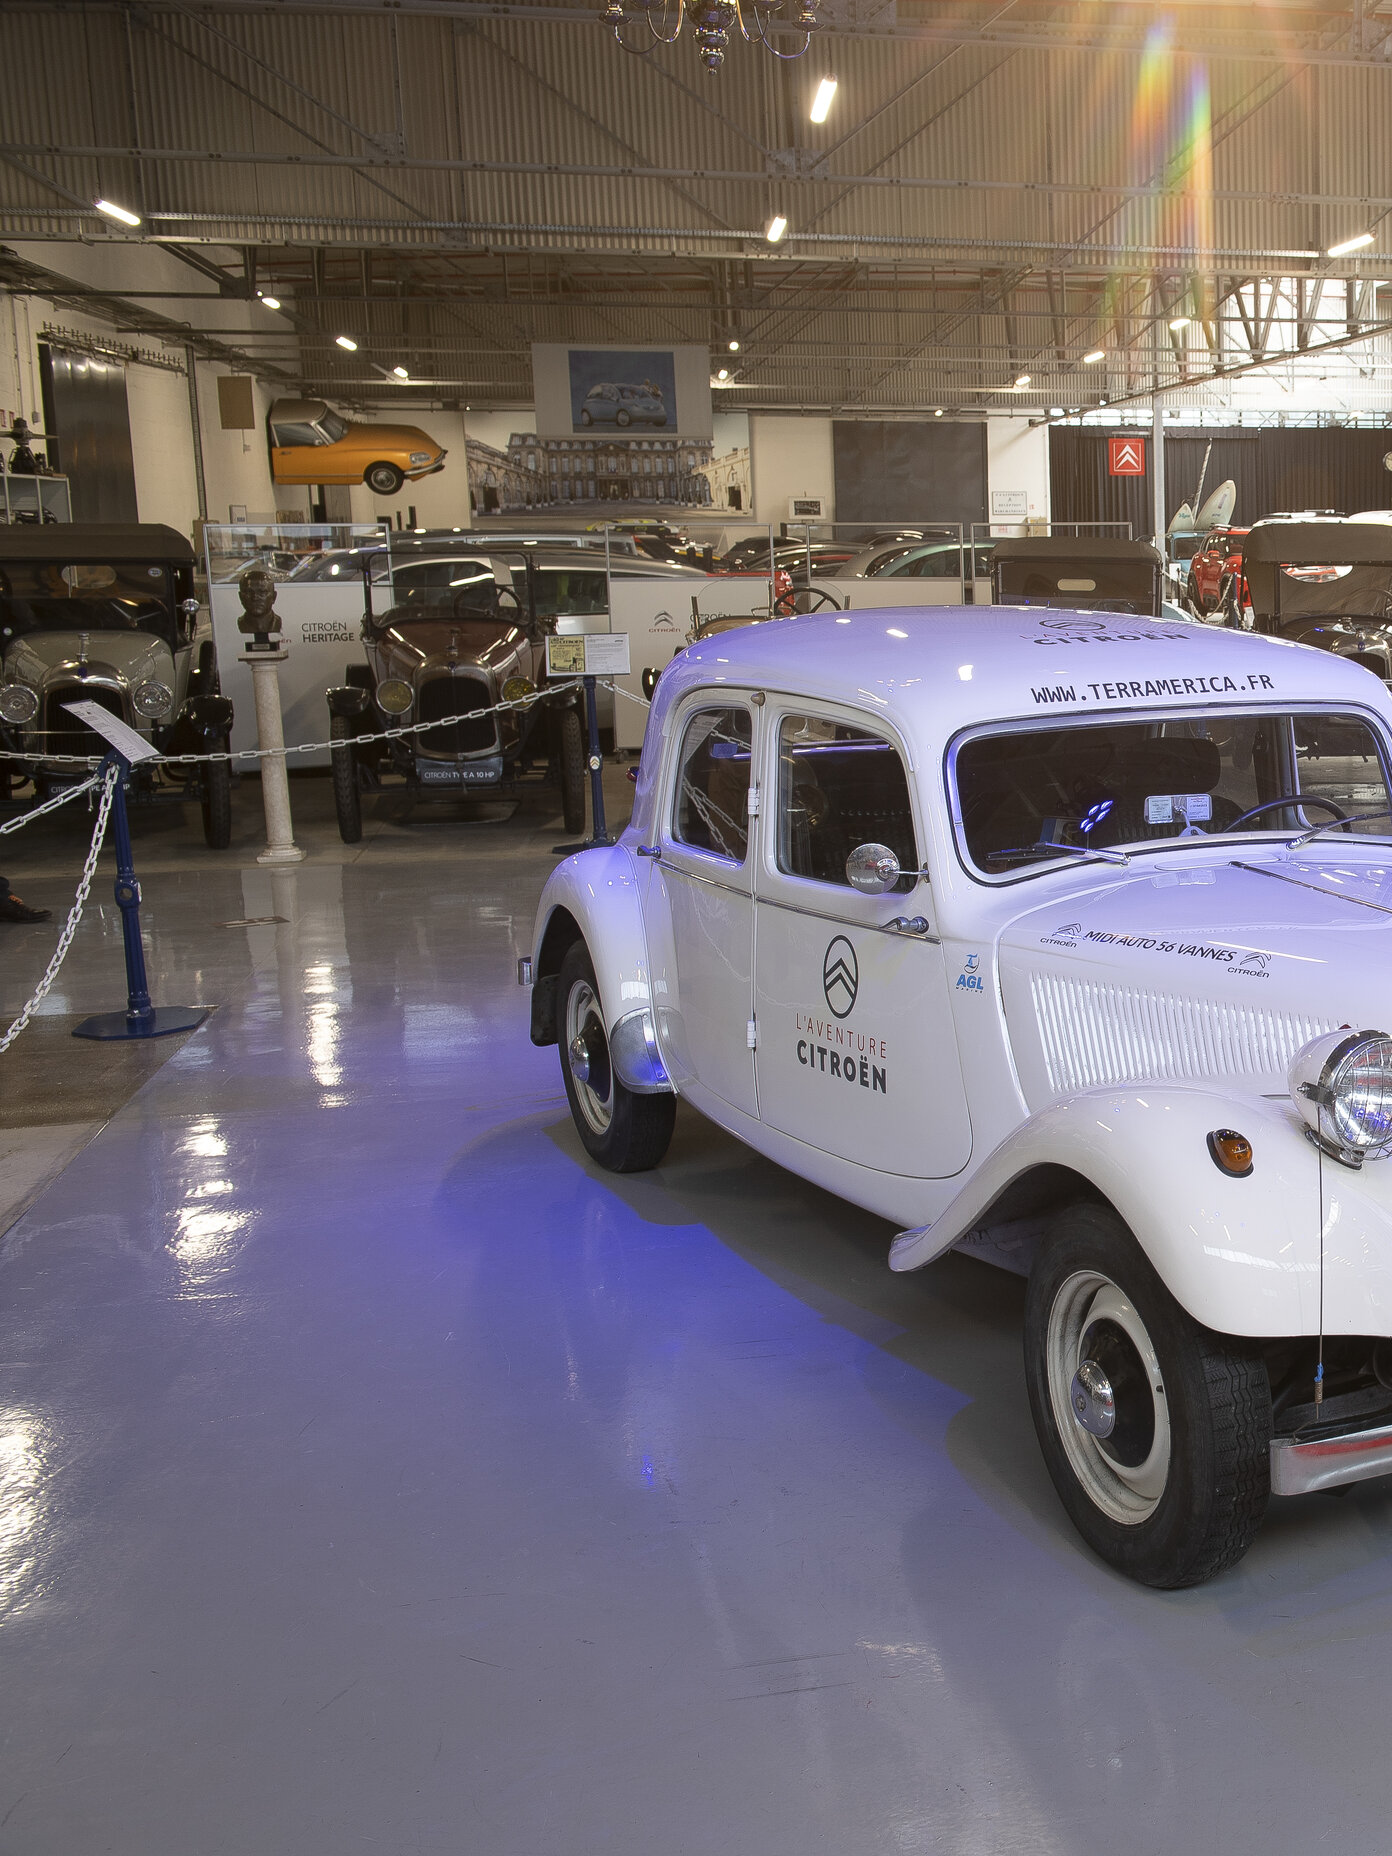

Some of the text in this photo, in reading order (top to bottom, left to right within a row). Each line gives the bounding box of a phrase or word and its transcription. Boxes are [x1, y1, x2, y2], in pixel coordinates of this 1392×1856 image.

[301, 621, 347, 632] CITROËN
[303, 632, 355, 643] HERITAGE
[1030, 674, 1275, 704] WWW.TERRAMERICA.FR
[1084, 930, 1238, 963] MIDI AUTO 56 VANNES
[955, 973, 984, 991] AGL
[796, 1012, 887, 1059] L'AVENTURE
[797, 1039, 887, 1094] CITROËN
